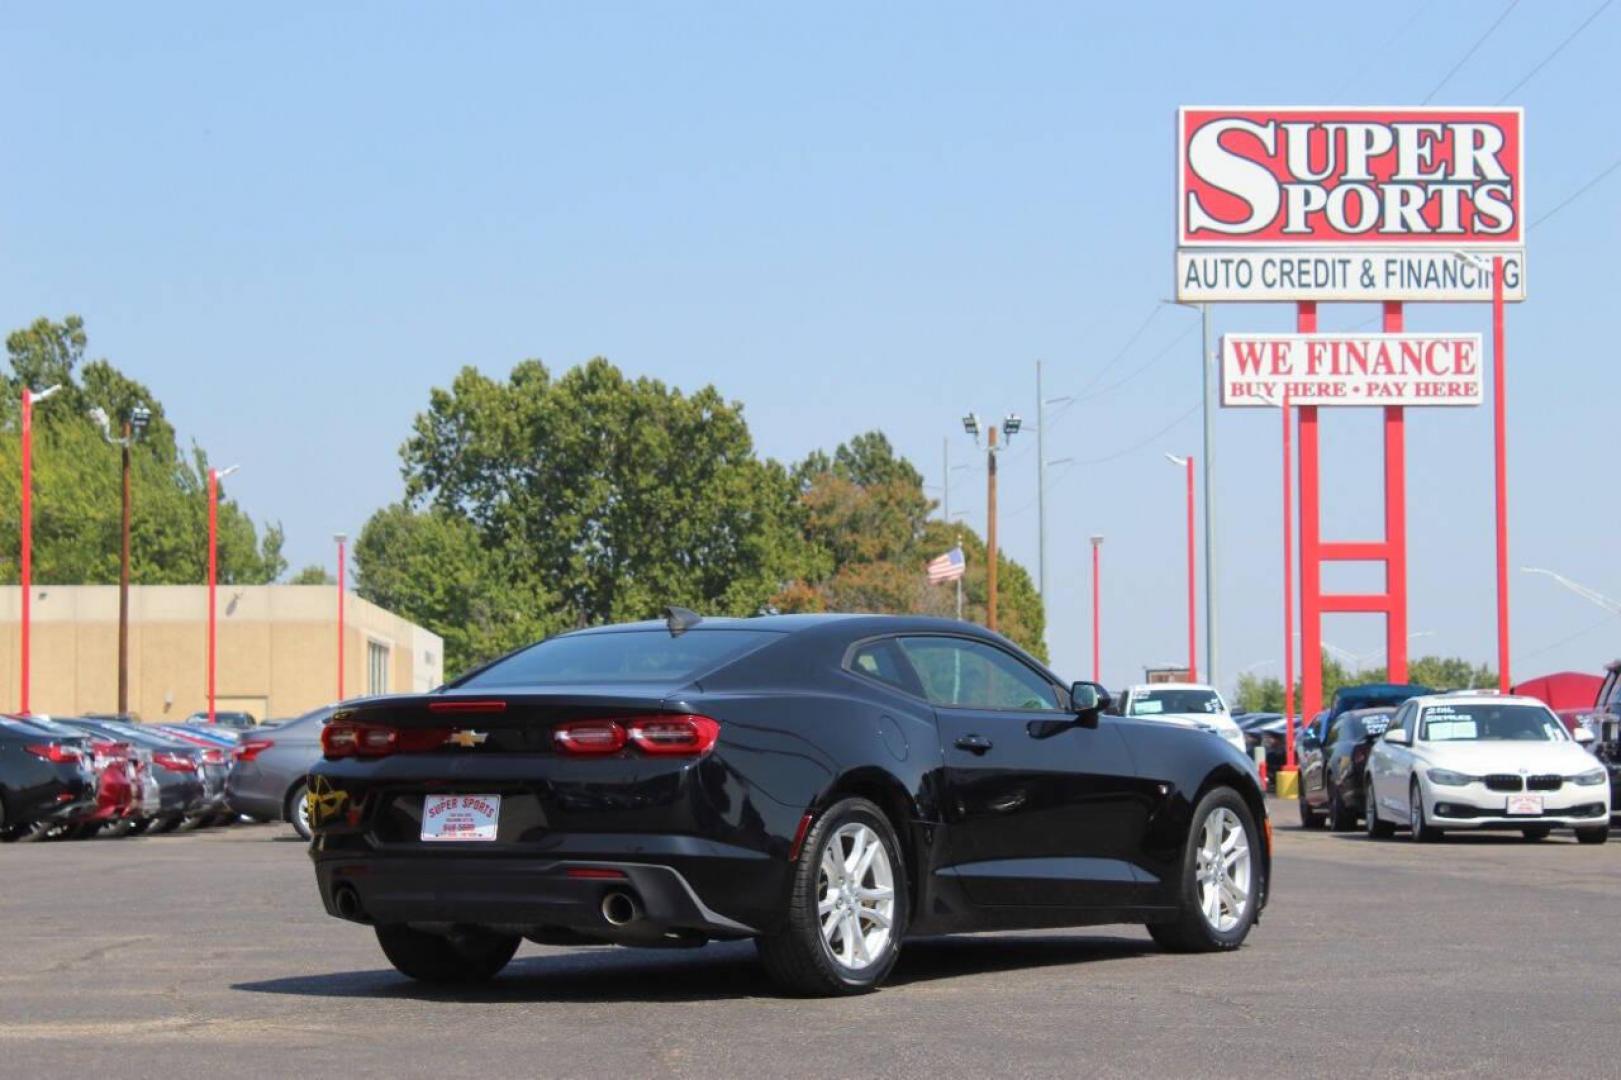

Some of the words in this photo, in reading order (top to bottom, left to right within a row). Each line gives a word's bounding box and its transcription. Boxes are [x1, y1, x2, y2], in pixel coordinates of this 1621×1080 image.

[1184, 258, 1253, 289] AUTO
[1261, 258, 1351, 289] CREDIT
[1359, 258, 1376, 289] &
[1231, 341, 1293, 375] WE
[1304, 340, 1476, 376] FINANCE
[1231, 381, 1276, 398] BUY
[1283, 381, 1347, 398] HERE
[1366, 381, 1407, 397] PAY
[1415, 381, 1479, 397] HERE
[428, 798, 457, 818] SUPER
[462, 798, 495, 818] SPORTS
